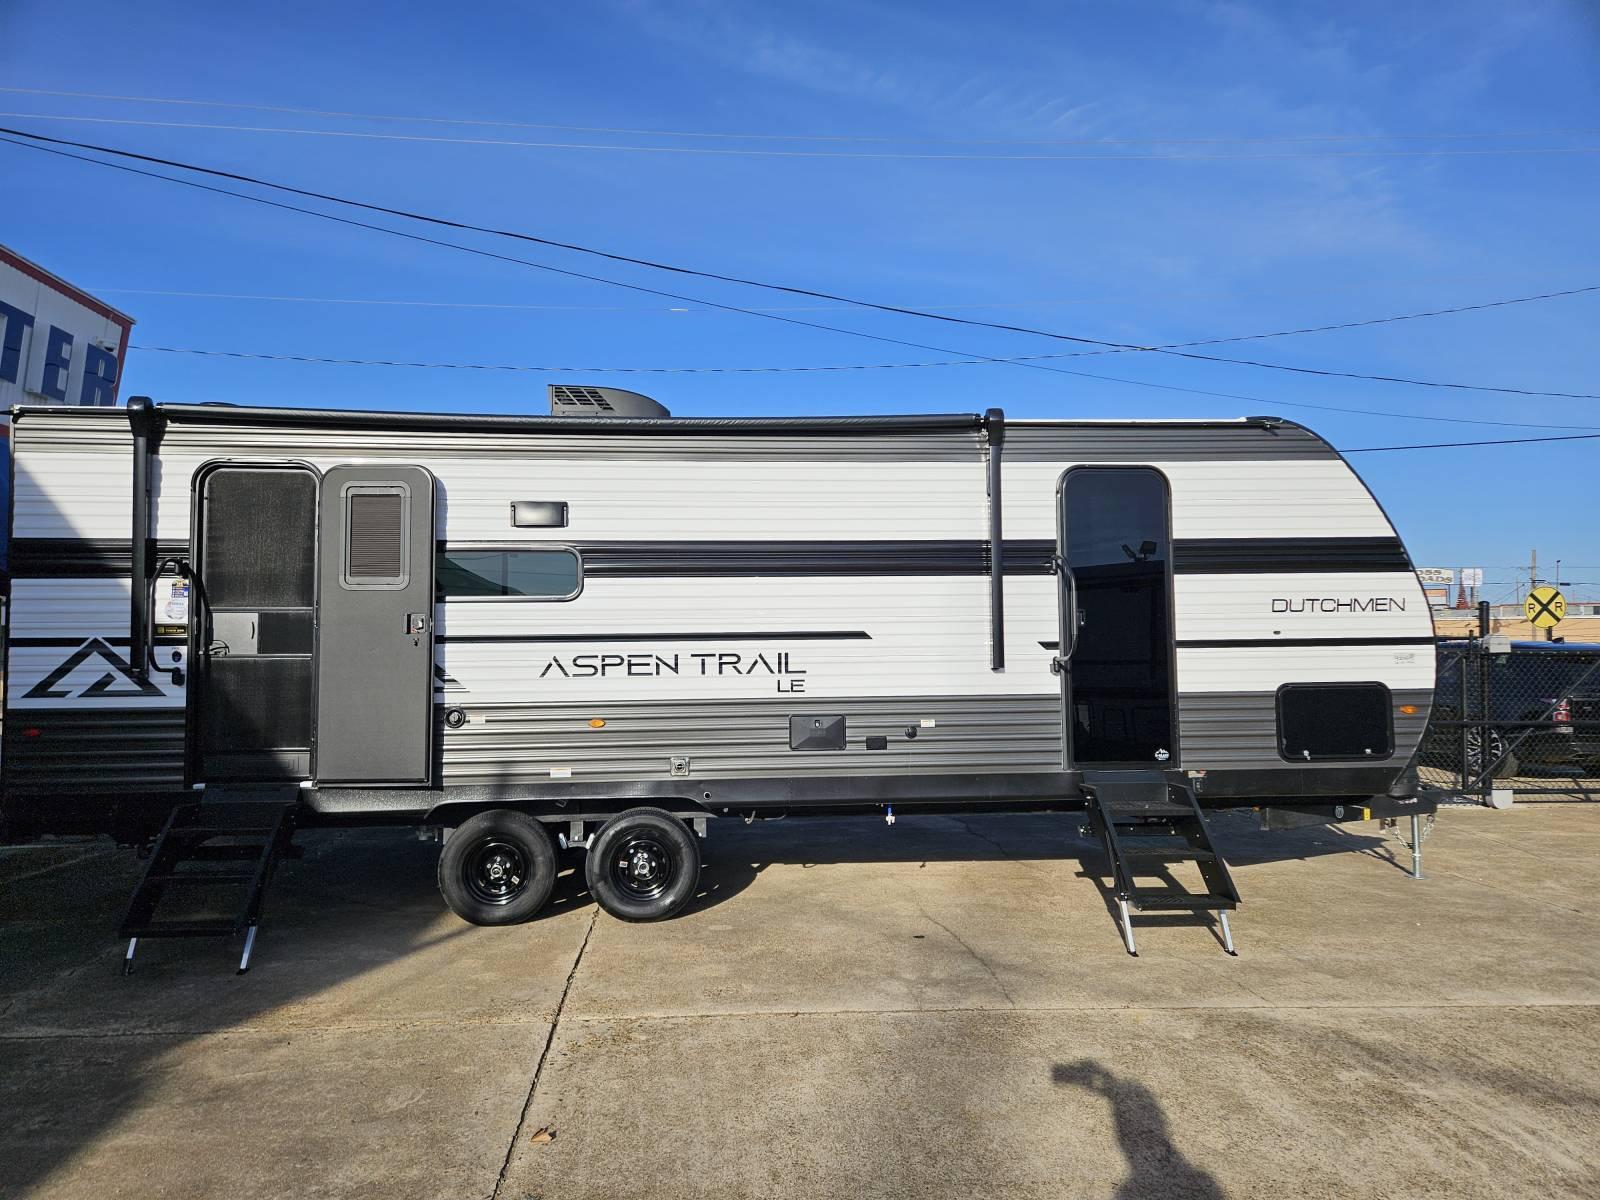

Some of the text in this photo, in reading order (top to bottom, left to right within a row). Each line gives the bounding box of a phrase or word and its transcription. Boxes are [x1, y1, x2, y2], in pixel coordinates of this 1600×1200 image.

[1271, 598, 1406, 613] DUTCHMEN
[1528, 601, 1563, 613] R R
[539, 652, 807, 678] ASPEN TRAIL
[777, 679, 806, 693] LE
